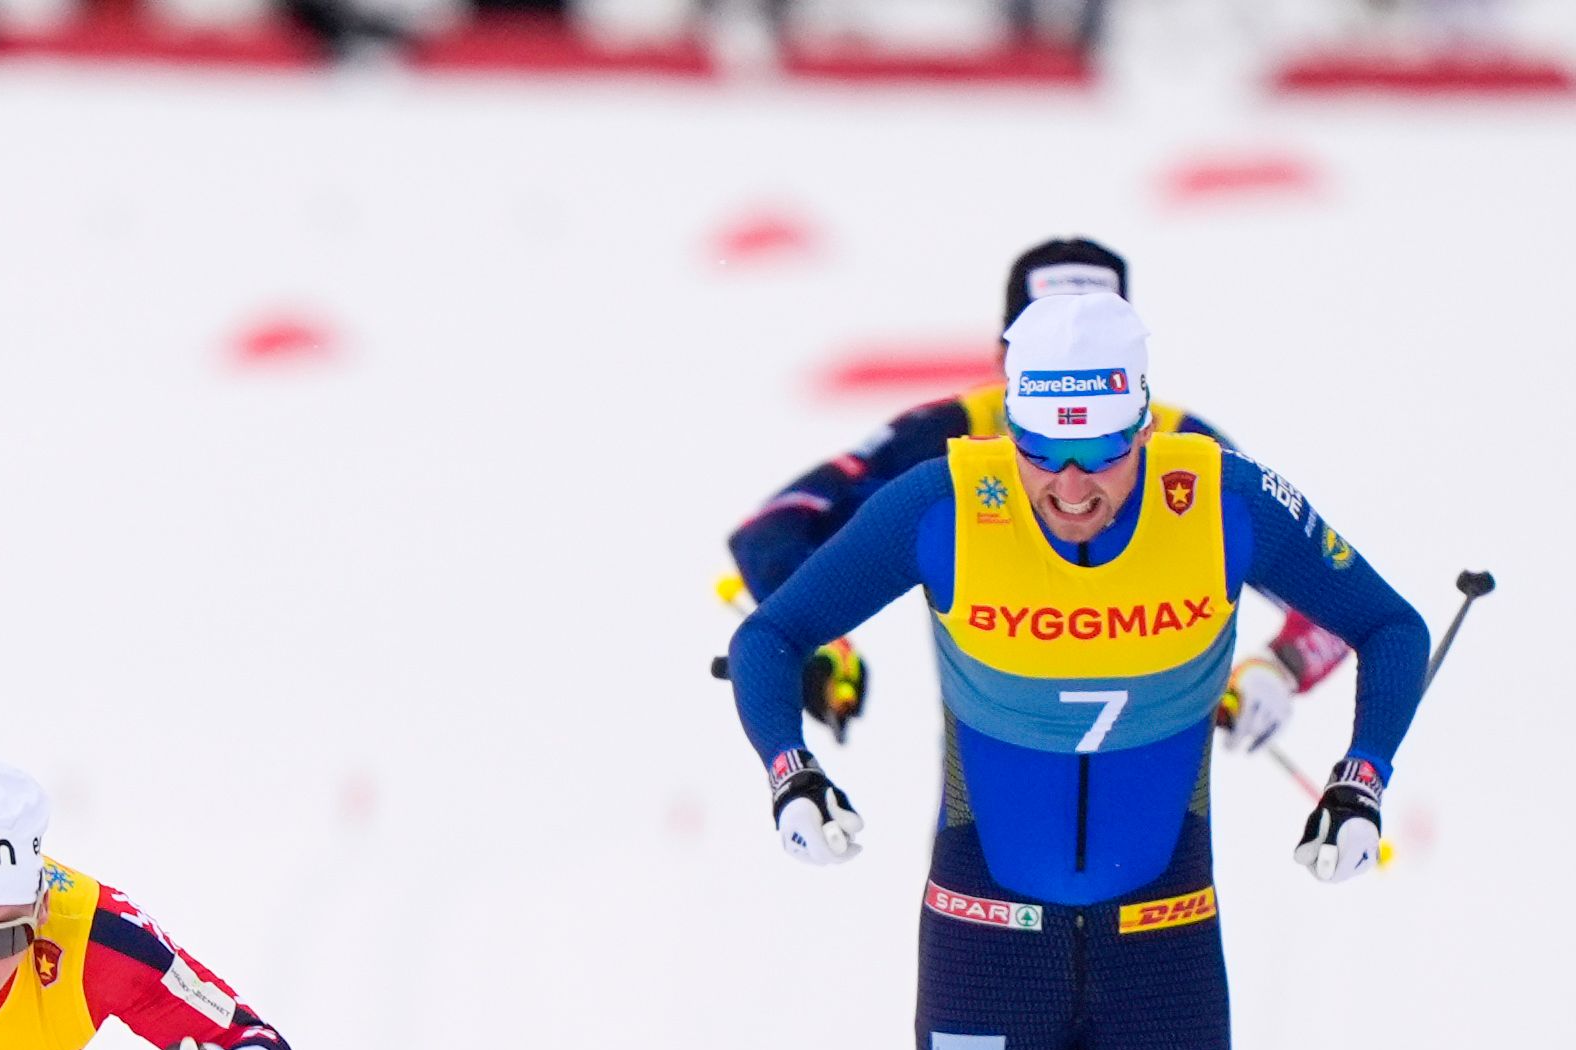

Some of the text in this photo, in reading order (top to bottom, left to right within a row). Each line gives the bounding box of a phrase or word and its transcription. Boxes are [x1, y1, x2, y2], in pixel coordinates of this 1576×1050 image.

[1019, 374, 1108, 395] SpareBank
[968, 596, 1212, 641] BYGGMAX
[1059, 690, 1129, 752] 7
[935, 891, 1010, 922] SPAR
[1138, 894, 1214, 926] DHL
